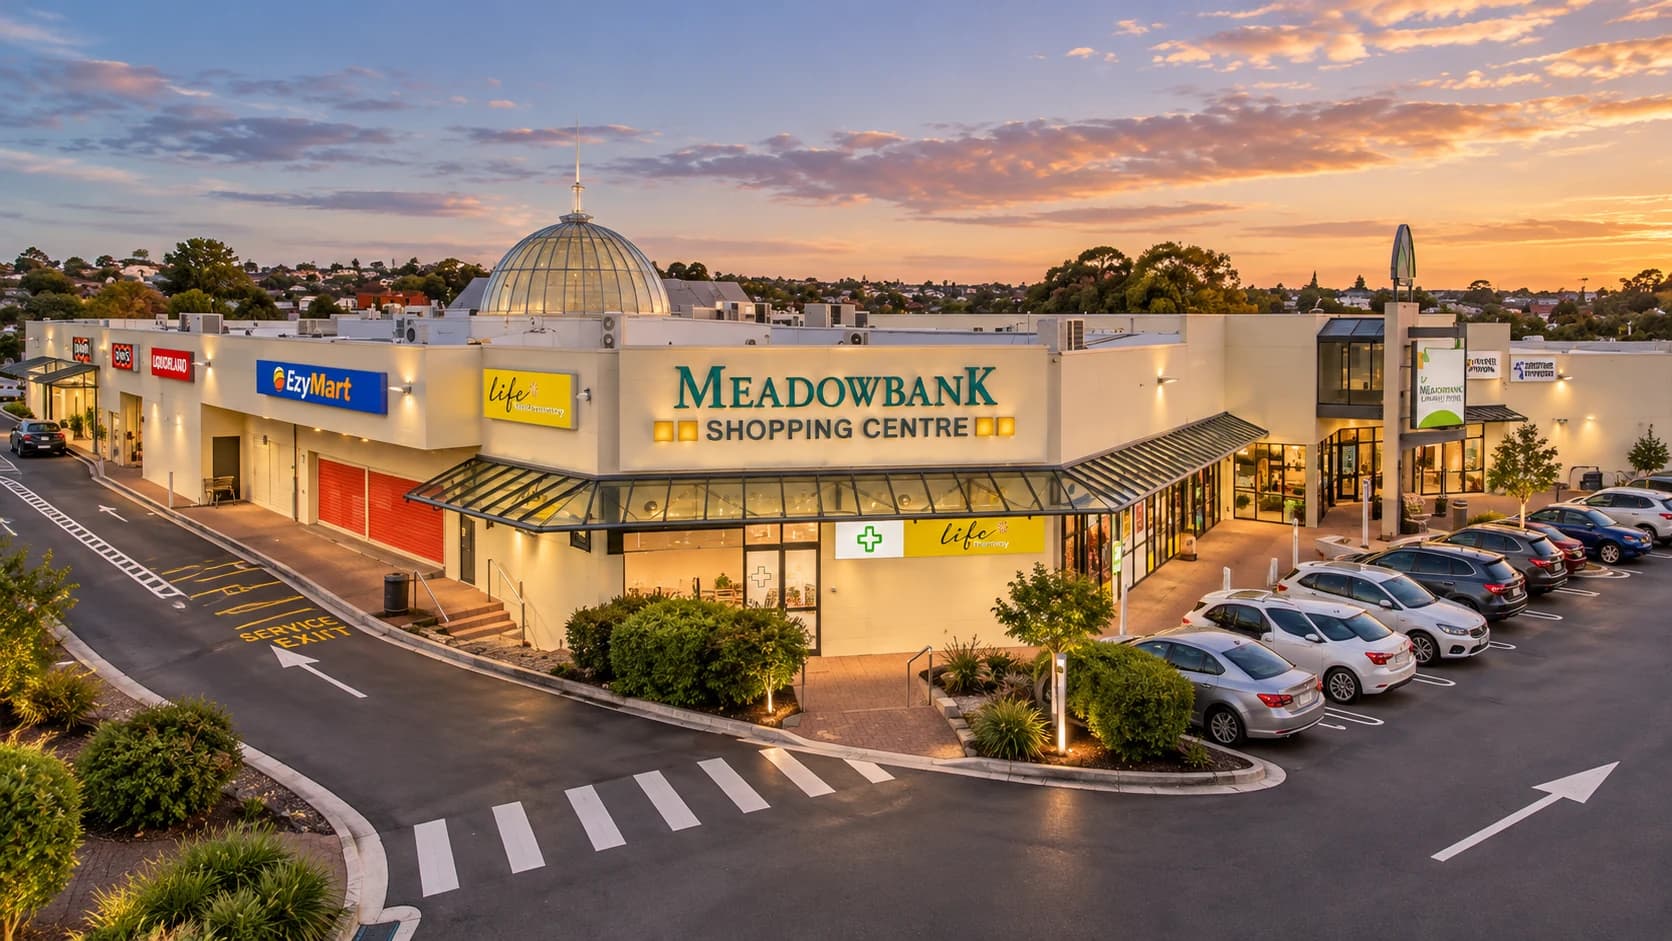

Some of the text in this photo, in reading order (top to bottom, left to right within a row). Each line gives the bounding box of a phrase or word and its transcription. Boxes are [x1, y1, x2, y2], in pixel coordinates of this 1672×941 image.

[287, 369, 352, 401] EzyMart
[489, 376, 530, 413] life
[674, 365, 998, 409] MEADOWBANK
[706, 417, 969, 442] SHOPPING CENTRE
[941, 520, 997, 551] life
[240, 616, 338, 642] SERVICE
